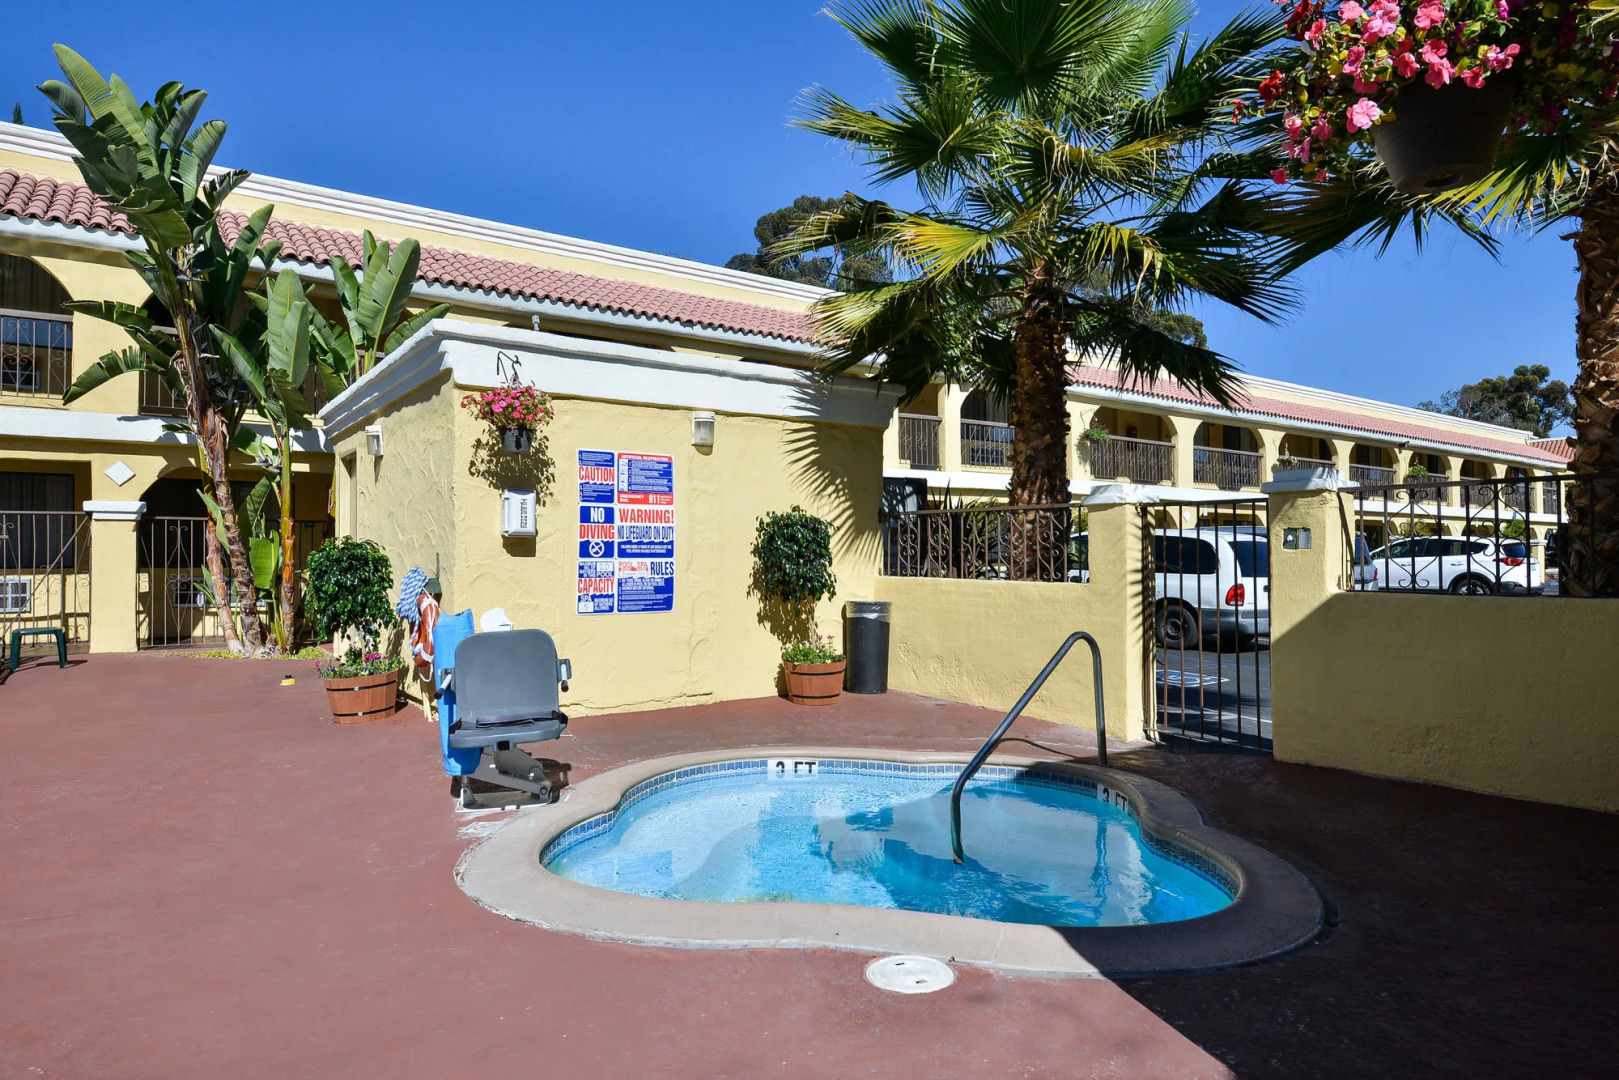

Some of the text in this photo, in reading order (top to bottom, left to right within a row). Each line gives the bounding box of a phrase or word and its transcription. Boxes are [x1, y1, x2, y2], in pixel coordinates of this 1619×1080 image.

[579, 466, 615, 482] CAUTION
[649, 494, 660, 504] 911
[590, 507, 605, 522] NO
[619, 508, 674, 524] WARNING!
[579, 524, 615, 539] DIVING
[618, 525, 674, 540] NO LIFEGUARD ON DUTY
[650, 562, 674, 576] RULES
[578, 578, 614, 593] CAPACITY
[1103, 787, 1128, 811] 3 FT
